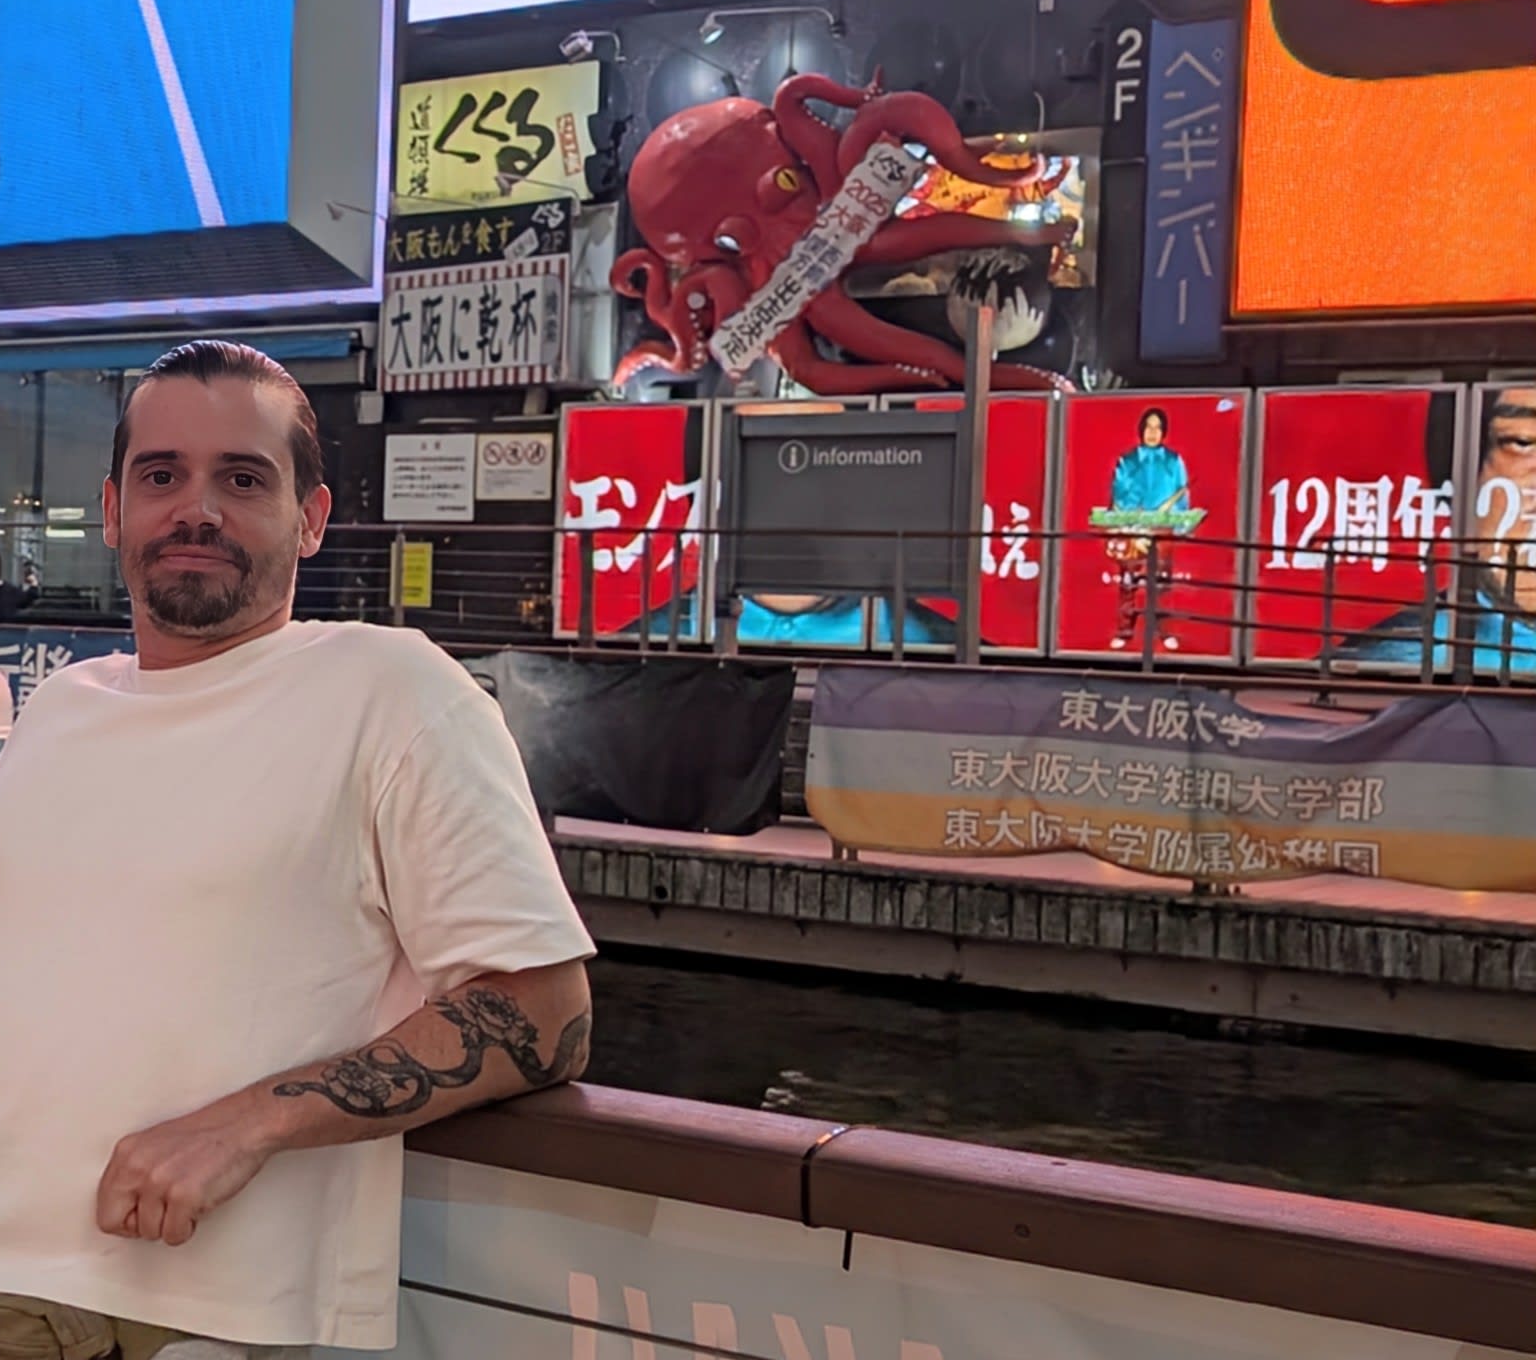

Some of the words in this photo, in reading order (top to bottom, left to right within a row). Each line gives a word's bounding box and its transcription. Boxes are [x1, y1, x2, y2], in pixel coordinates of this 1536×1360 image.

[1114, 27, 1143, 122] 2F
[434, 87, 556, 184] くくる
[845, 178, 891, 217] 2025
[1156, 47, 1224, 325] ペンギンバー
[812, 446, 923, 468] information
[1266, 474, 1454, 572] 12周年
[949, 749, 1386, 822] 東大阪大学短期大学部
